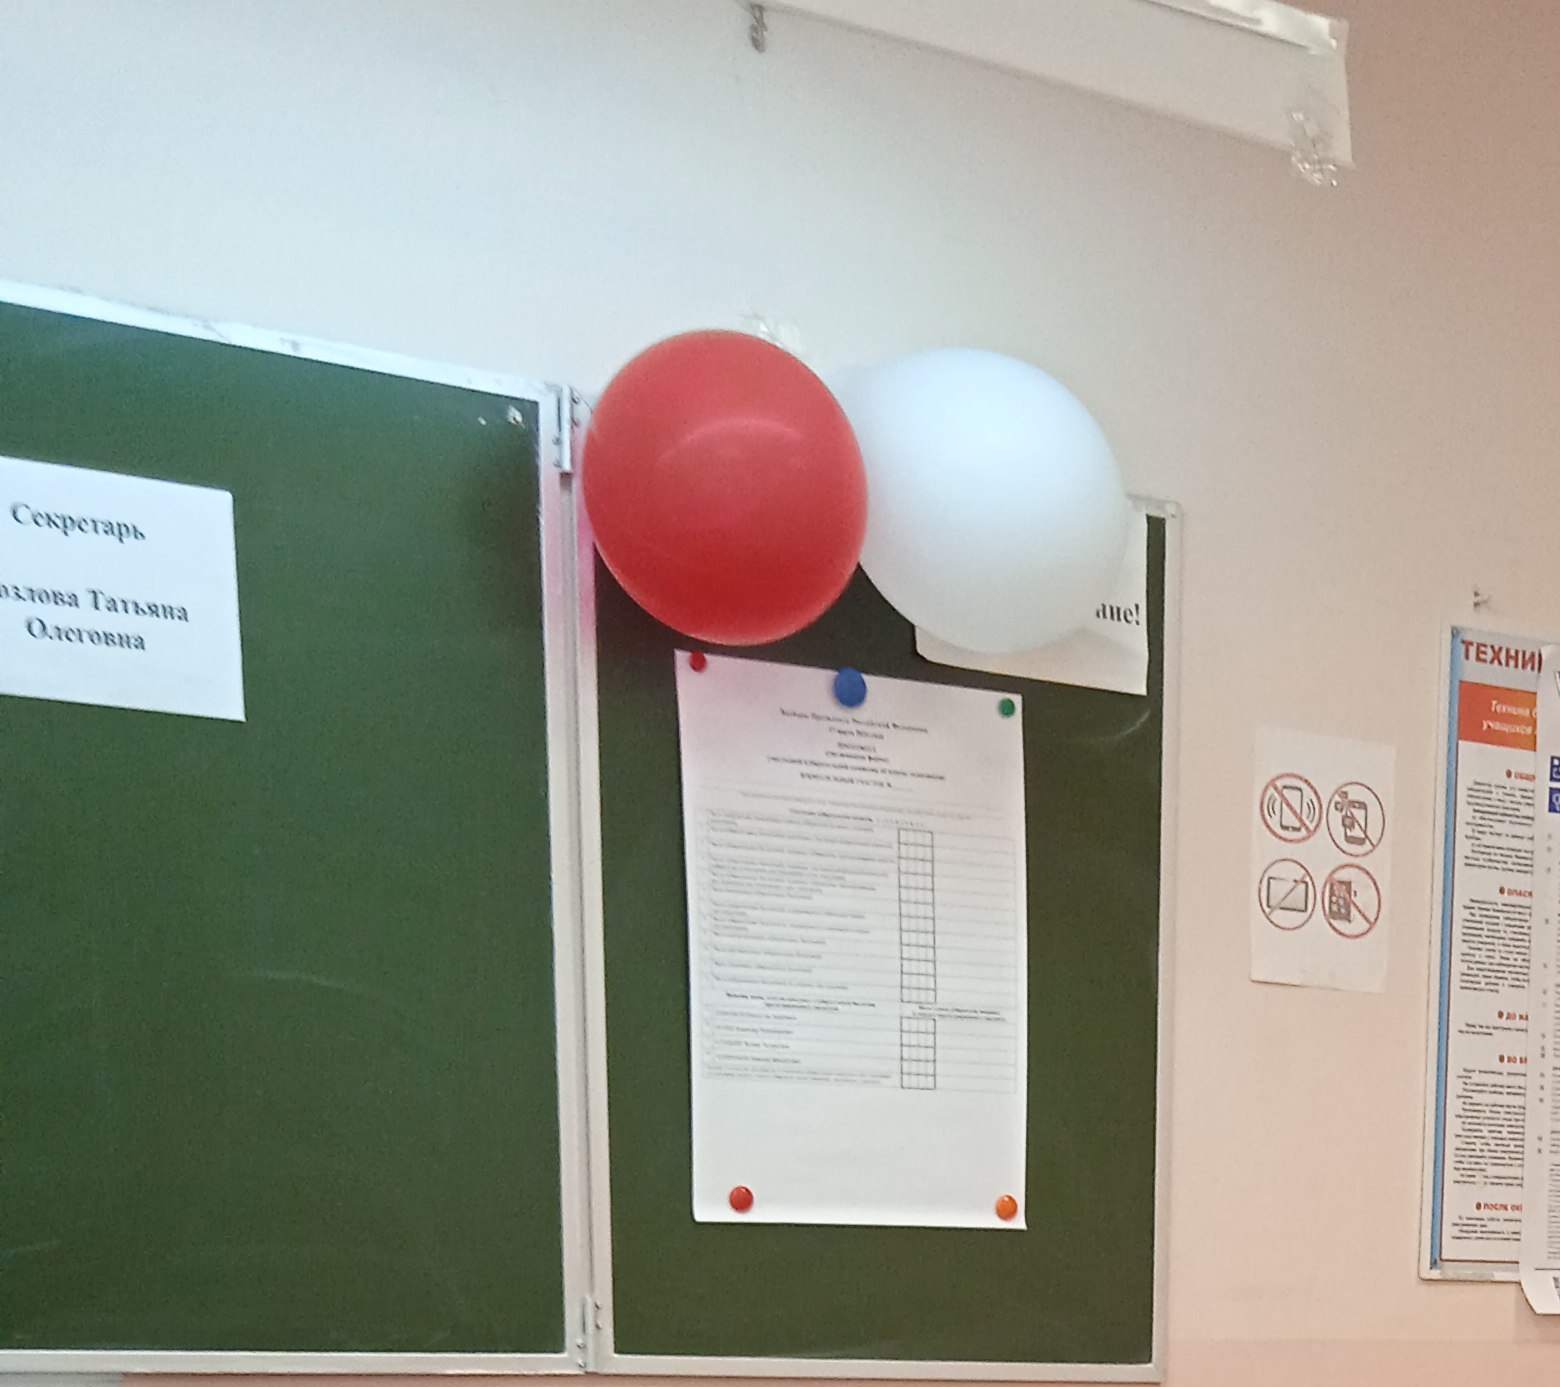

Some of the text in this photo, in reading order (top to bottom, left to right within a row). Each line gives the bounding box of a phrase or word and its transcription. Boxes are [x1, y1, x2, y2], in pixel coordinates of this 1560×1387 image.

[10, 502, 146, 544] Секретарь
[87, 588, 189, 623] Татьяна
[25, 616, 146, 651] Олеговна
